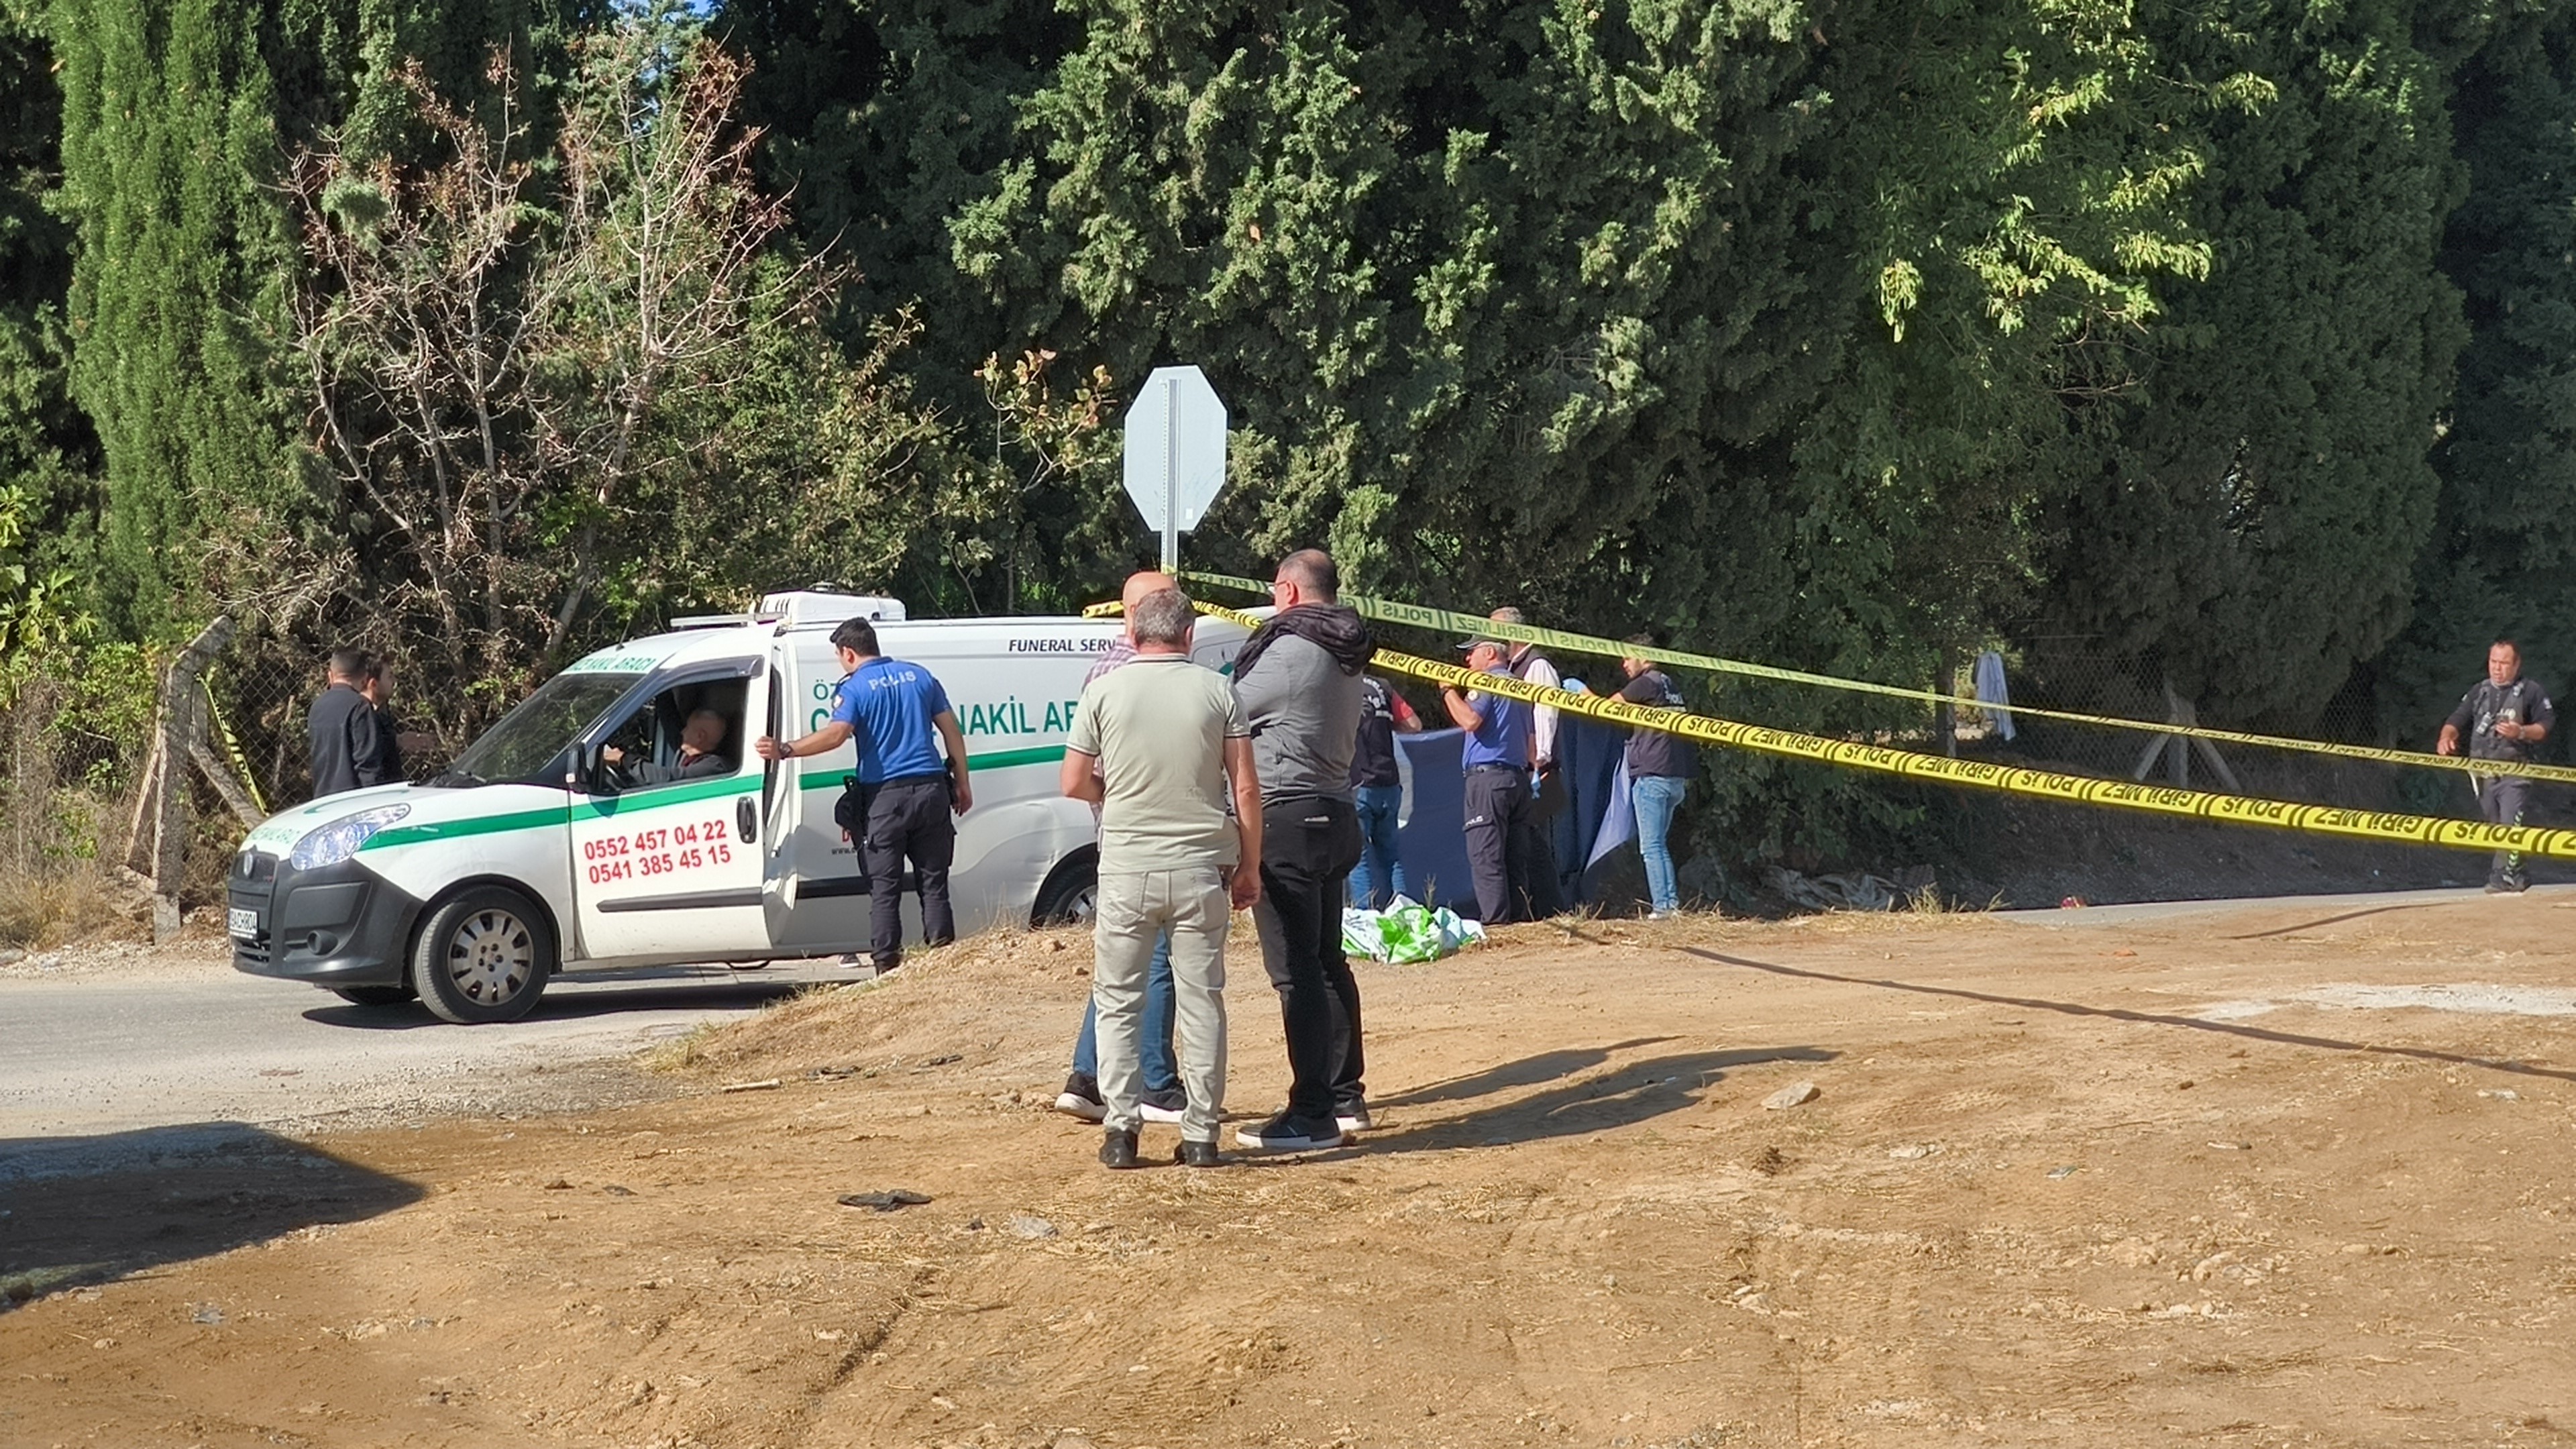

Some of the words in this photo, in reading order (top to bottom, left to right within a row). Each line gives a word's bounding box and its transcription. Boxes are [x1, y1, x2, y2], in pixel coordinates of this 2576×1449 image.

[1009, 639, 1075, 652] FUNERAL
[1080, 639, 1116, 652] SERV
[584, 836, 629, 860] 0552
[635, 828, 667, 851] 457
[674, 824, 698, 845] 04
[703, 819, 727, 841] 22
[589, 860, 632, 884] 0541
[639, 853, 674, 876] 385
[680, 848, 702, 869] 45
[708, 843, 731, 865] 15
